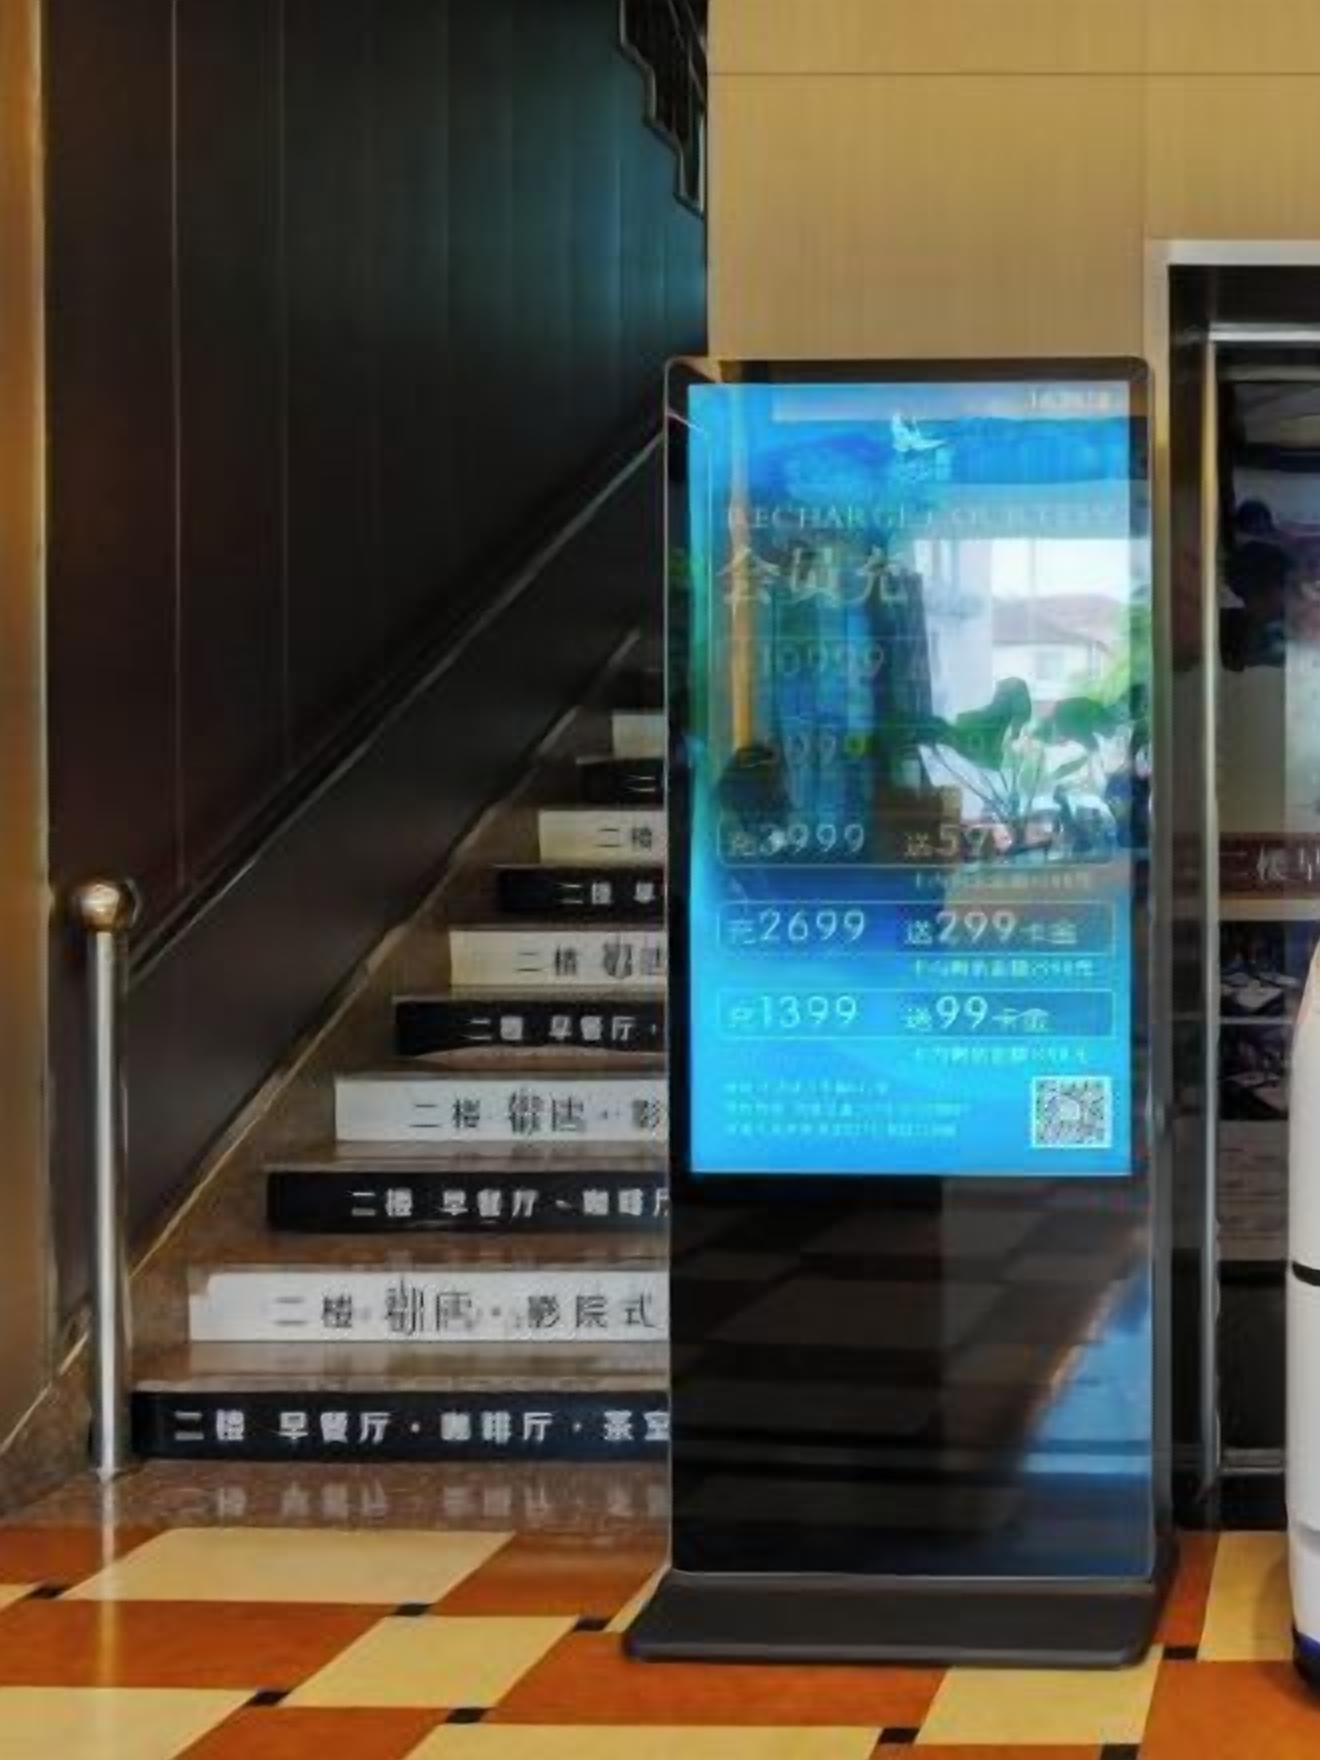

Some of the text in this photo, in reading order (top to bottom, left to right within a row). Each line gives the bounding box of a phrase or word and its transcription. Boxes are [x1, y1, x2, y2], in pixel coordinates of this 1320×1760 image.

[410, 1100, 481, 1130] 二楼
[274, 1293, 354, 1330] 二楼
[174, 1410, 245, 1443] 二楼
